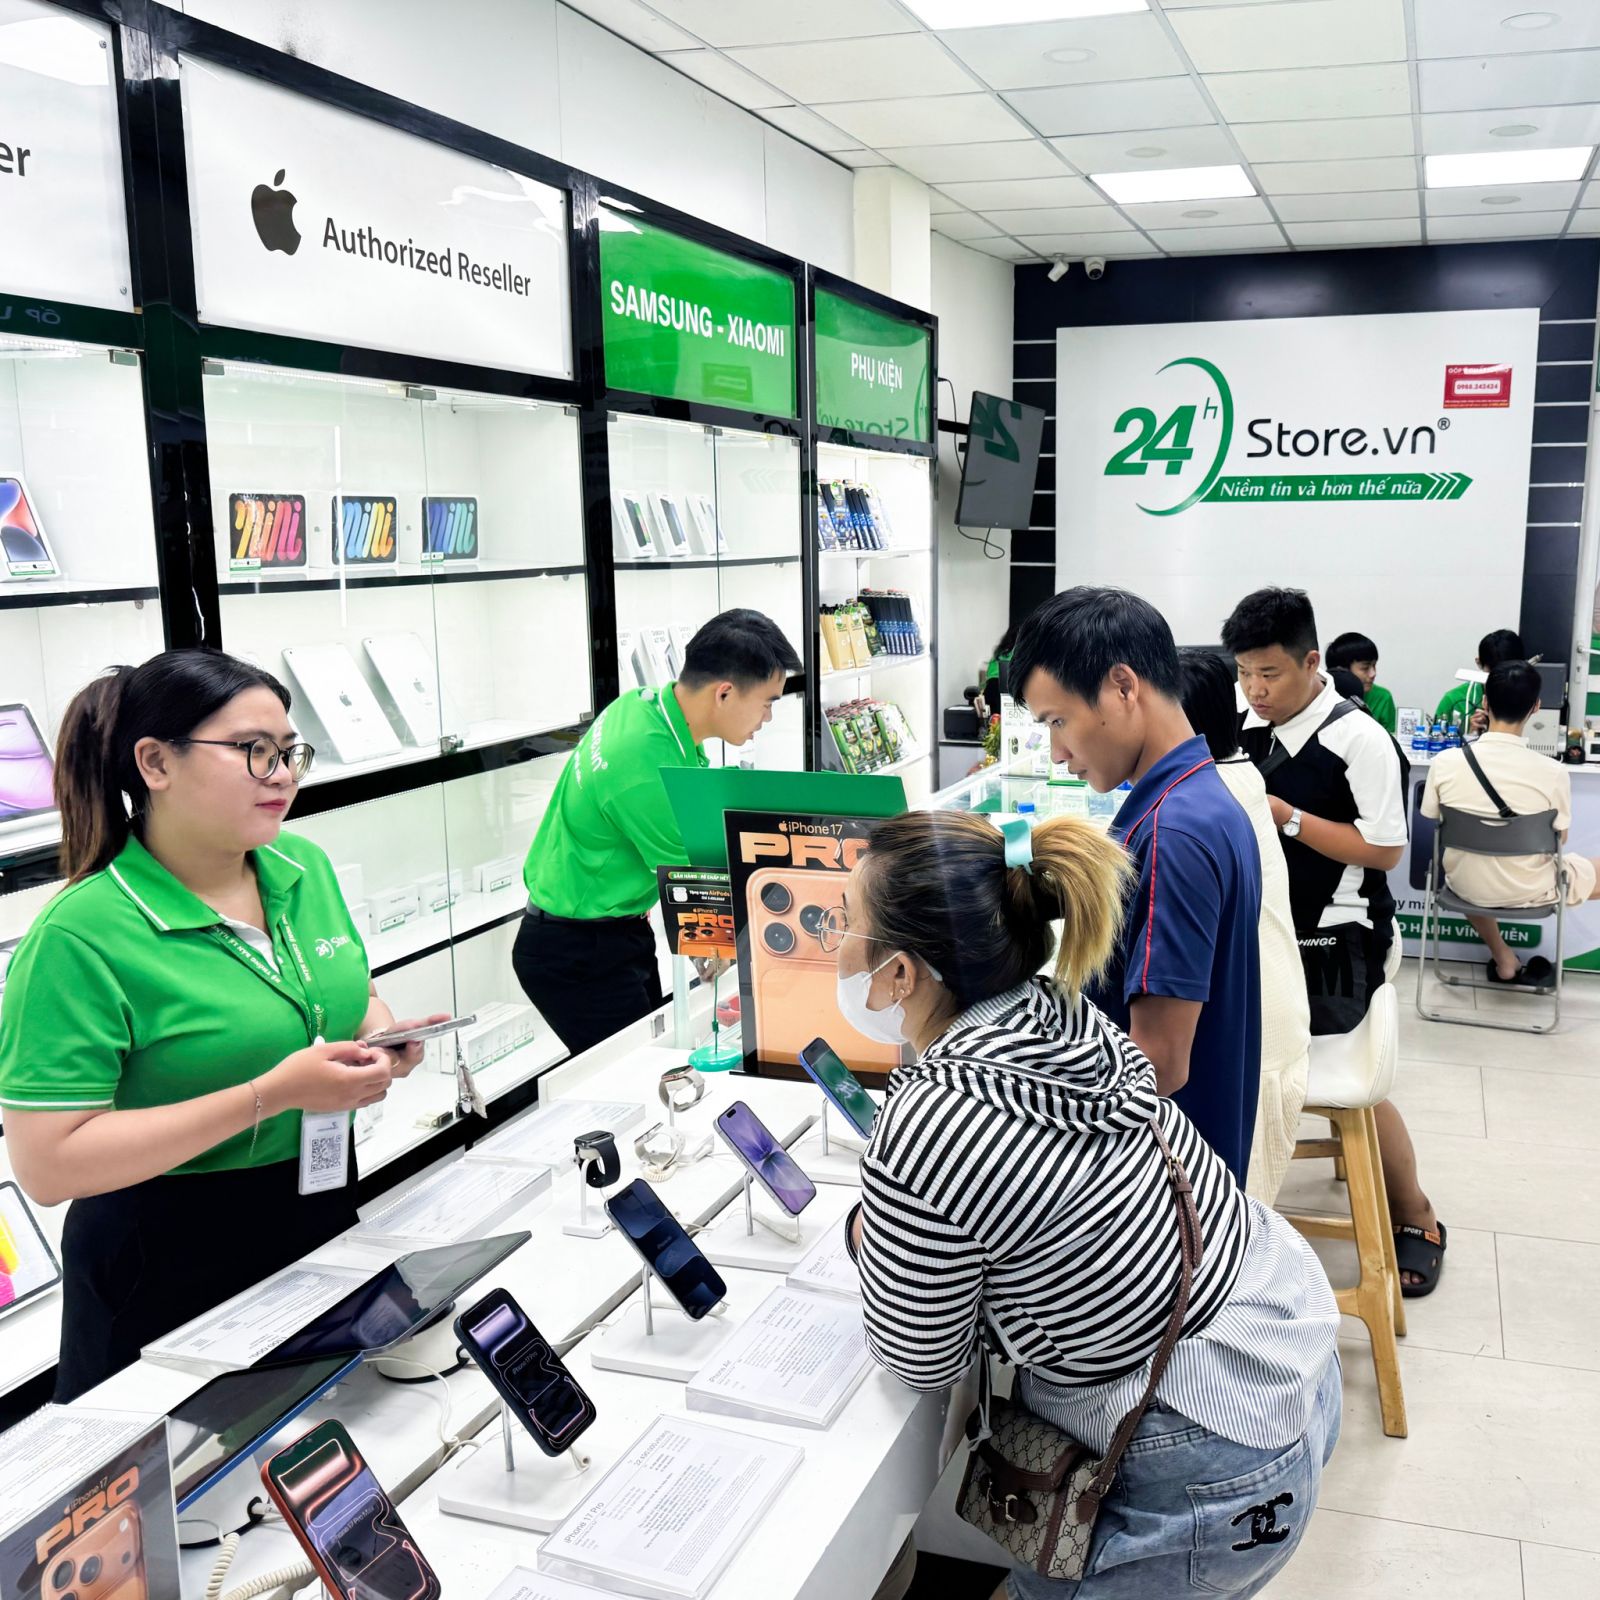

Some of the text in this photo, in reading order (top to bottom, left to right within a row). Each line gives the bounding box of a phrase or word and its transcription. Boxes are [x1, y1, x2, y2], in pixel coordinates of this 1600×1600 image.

[322, 217, 532, 297] Authorized Reseller
[610, 279, 713, 339] SAMSUNG
[727, 313, 785, 357] XIAOMI
[851, 352, 903, 394] PHỤ KIỆN
[1220, 477, 1422, 497] Niềm tin và hơn thế nữa
[788, 821, 843, 835] iPhone 17
[1455, 924, 1480, 937] VĨN
[1403, 1226, 1423, 1235] SPORT
[70, 1476, 108, 1511] iPhone 17
[36, 1465, 140, 1565] PRO
[563, 1522, 587, 1544] iPhone
[583, 1512, 593, 1521] 17
[590, 1502, 605, 1514] Pro
